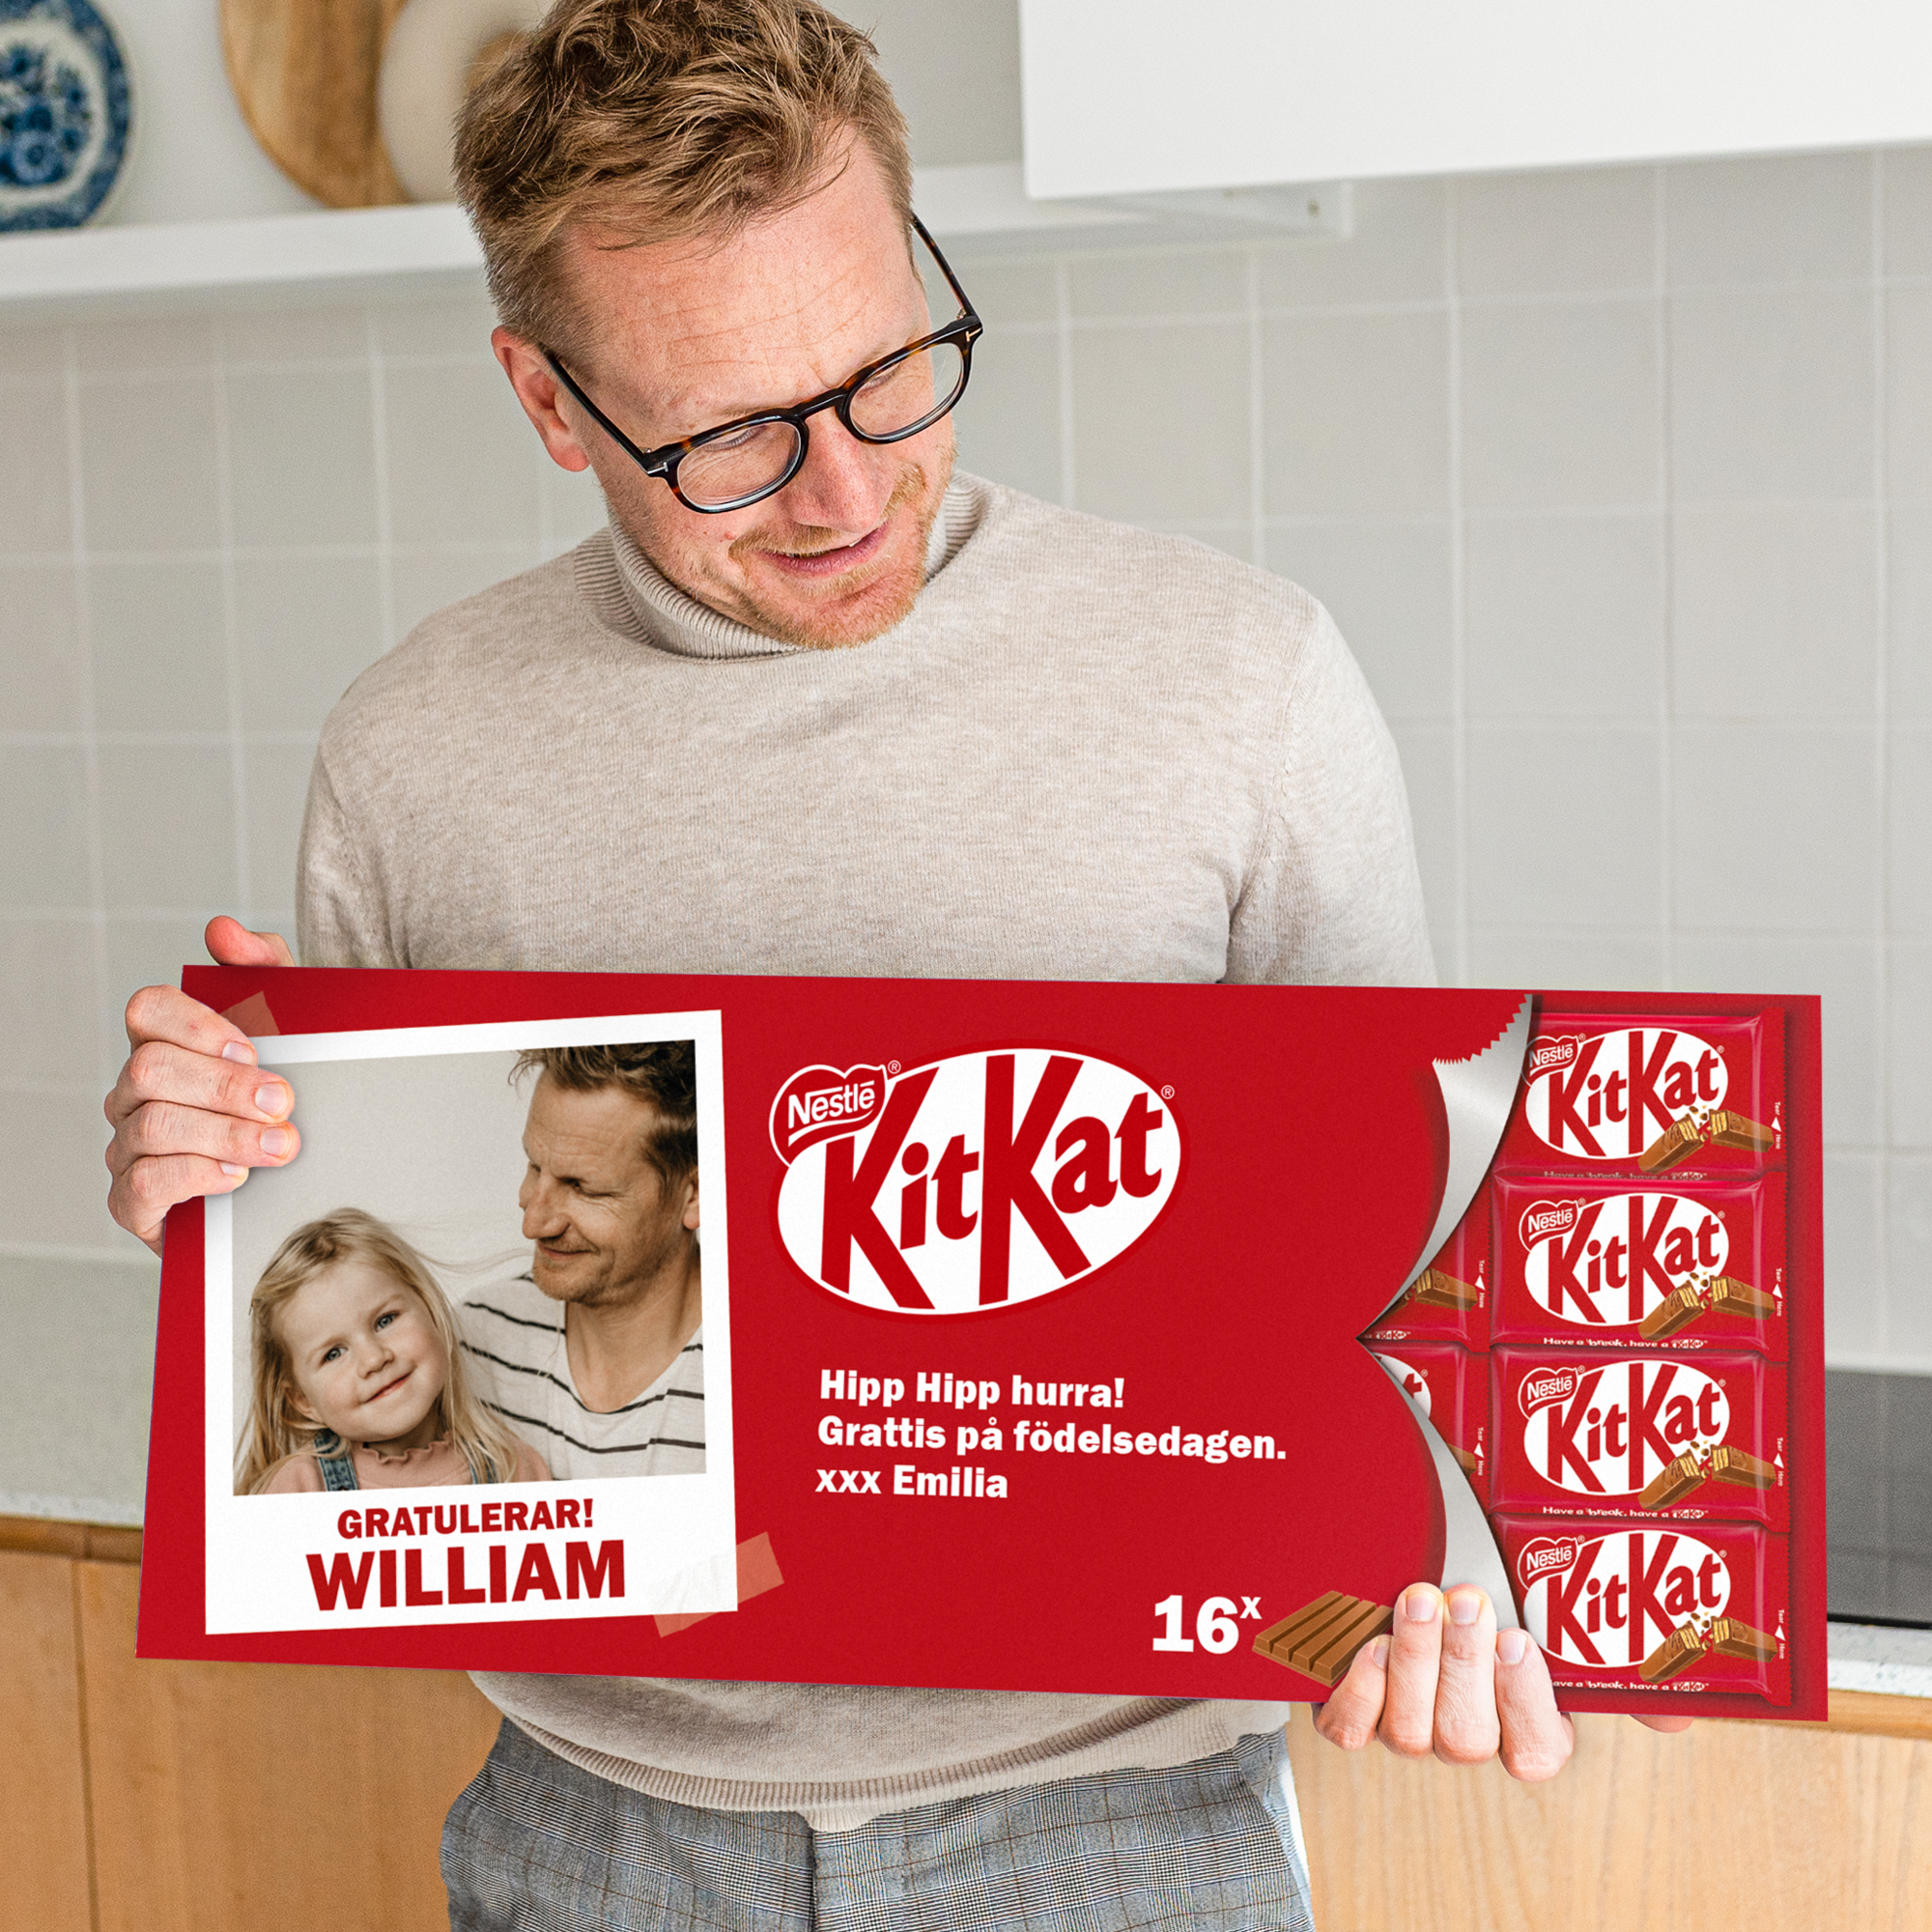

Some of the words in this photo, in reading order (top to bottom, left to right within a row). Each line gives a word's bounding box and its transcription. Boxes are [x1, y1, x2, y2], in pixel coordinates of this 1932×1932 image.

[1548, 1031, 1719, 1157] KitKat
[821, 1054, 1163, 1310] KitKat
[1548, 1195, 1720, 1323] KitKat
[1544, 1337, 1575, 1346] Have
[820, 1369, 905, 1407] Hipp
[917, 1372, 1001, 1410] Hipp
[1011, 1375, 1124, 1408] hurra!
[818, 1415, 947, 1449] Grattis
[957, 1416, 1003, 1456] på
[1013, 1420, 1287, 1464] födelsedagen.
[1548, 1363, 1720, 1492] KitKat
[814, 1469, 882, 1494] xxx
[894, 1464, 1008, 1498] Emilia
[337, 1498, 593, 1540] GRATULERAR!
[1543, 1506, 1574, 1515] Have
[1630, 1509, 1658, 1518] have
[305, 1539, 625, 1611] WILLIAM
[1547, 1533, 1721, 1665] KitKat
[1630, 1682, 1658, 1690] have
